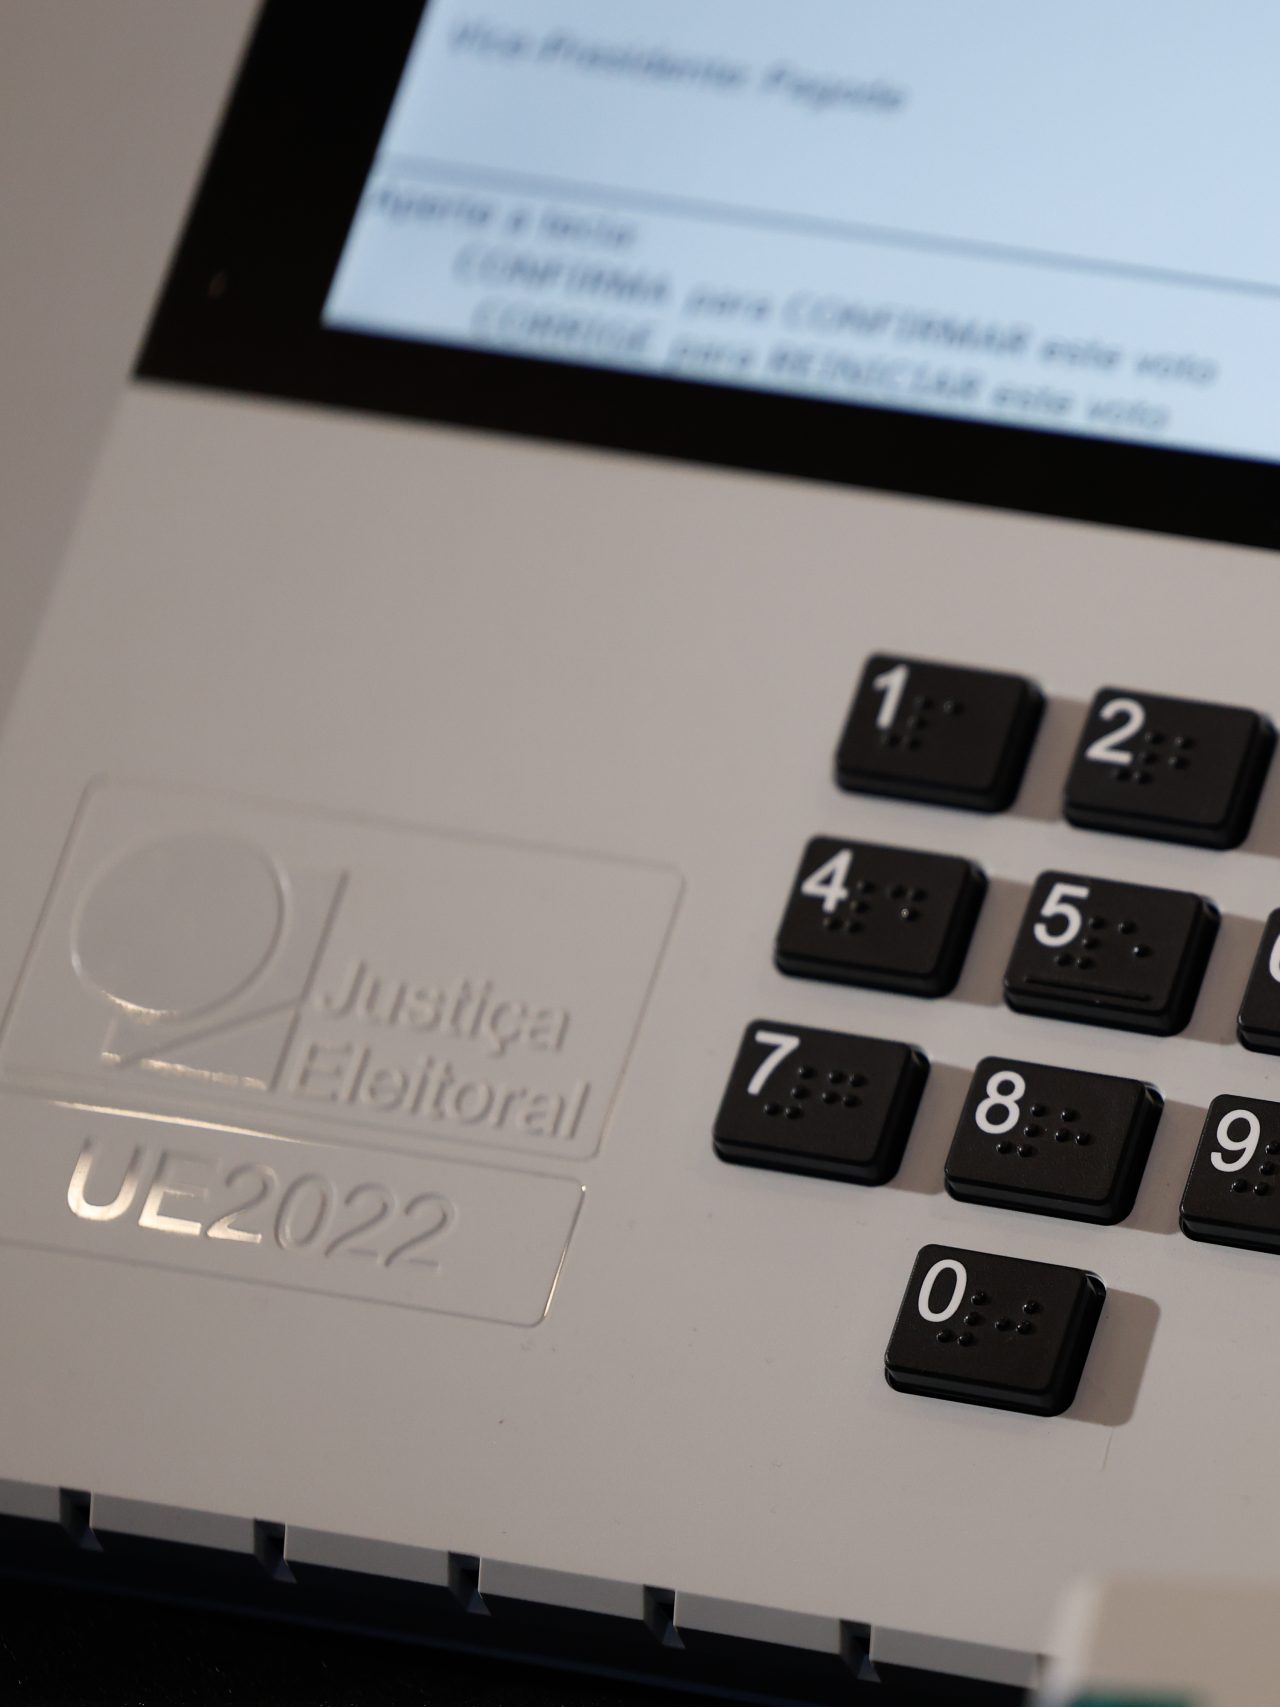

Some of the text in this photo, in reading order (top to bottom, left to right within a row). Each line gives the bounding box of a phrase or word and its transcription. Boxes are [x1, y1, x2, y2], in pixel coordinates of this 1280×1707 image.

[452, 240, 1219, 389] CONFIRMA para CONFIRMAR este voto
[667, 335, 756, 374] para
[765, 339, 985, 401] REINICIAR
[1086, 398, 1171, 433] voto
[872, 664, 909, 730] 1
[1085, 698, 1145, 766] 2
[801, 849, 853, 913] 4
[1033, 882, 1090, 948] 5
[322, 959, 572, 1058] Justiça
[300, 1040, 593, 1140] Eleitoral
[746, 1030, 800, 1095] 7
[974, 1070, 1026, 1135] 8
[1210, 1109, 1261, 1173] 9
[67, 1136, 455, 1270] UE2022
[917, 1259, 967, 1323] 0
